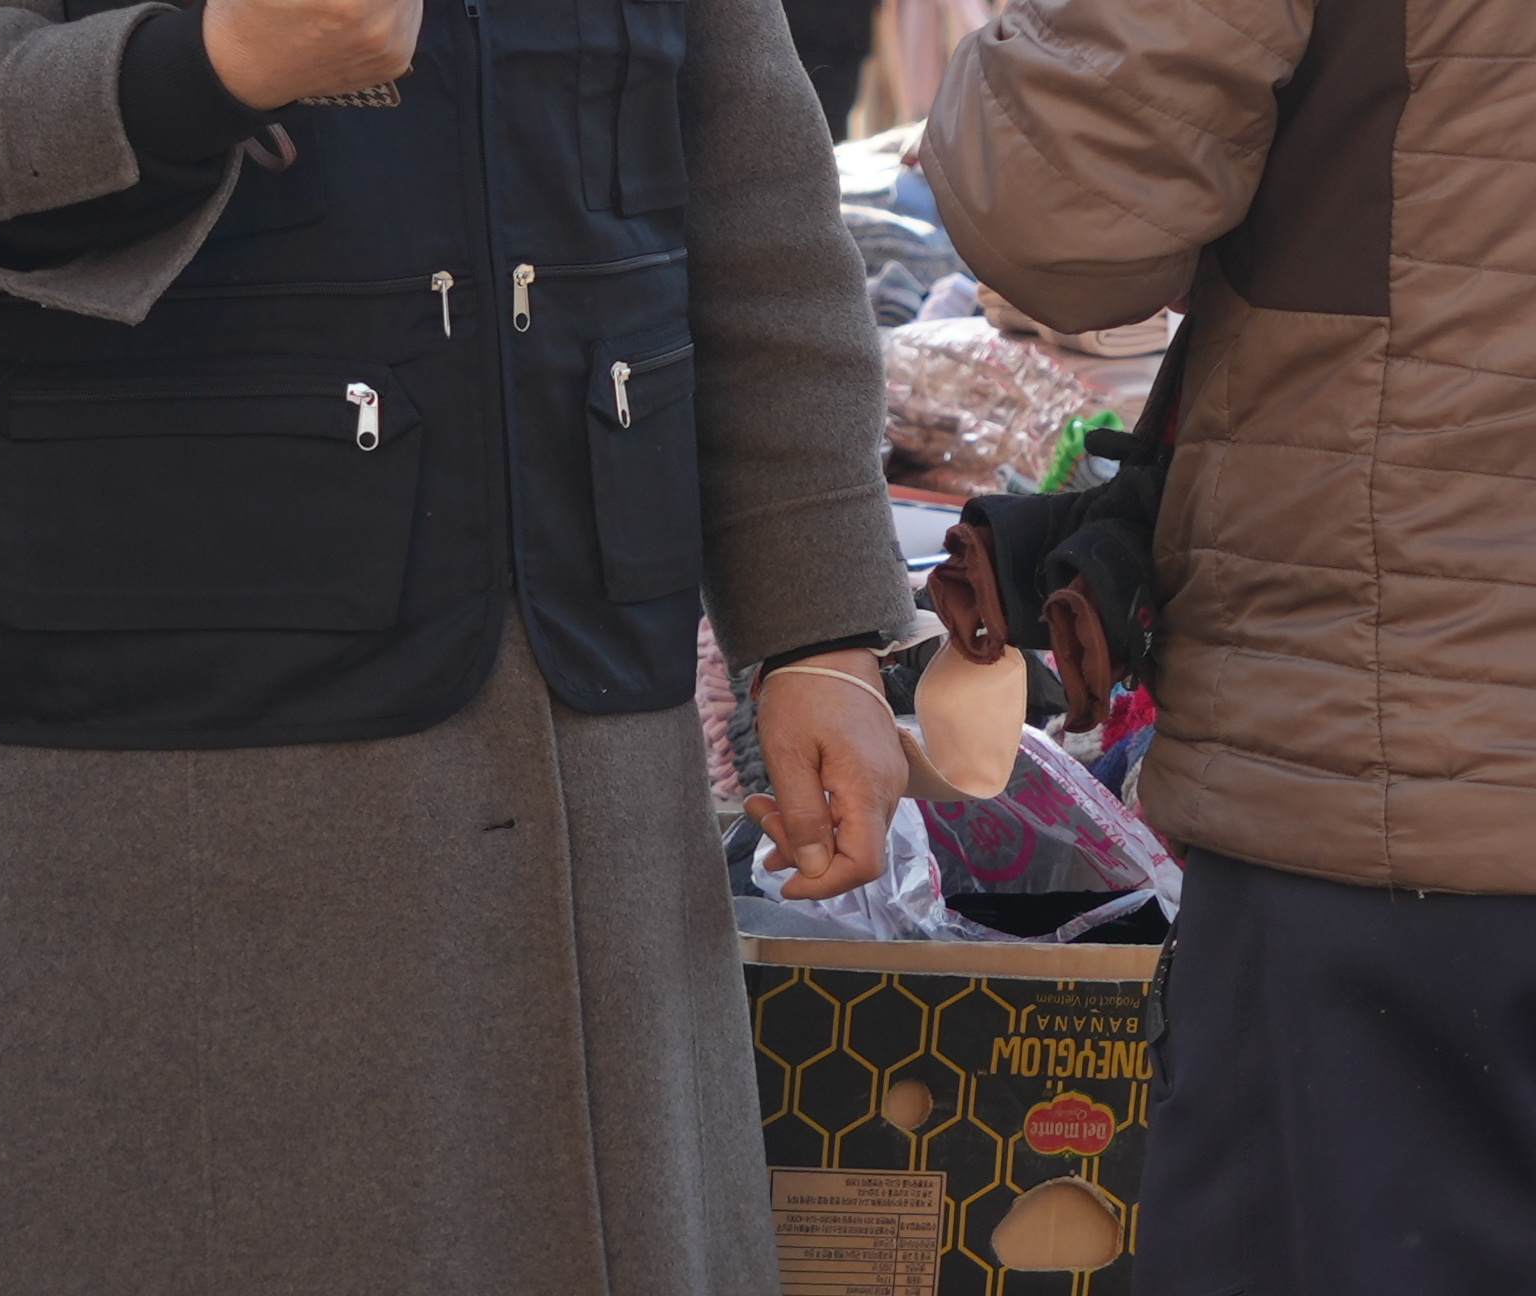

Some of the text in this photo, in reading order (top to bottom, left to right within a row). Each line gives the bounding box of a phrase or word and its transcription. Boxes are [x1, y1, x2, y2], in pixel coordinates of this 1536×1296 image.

[1036, 993, 1141, 1009] Product of Vietnam
[1036, 1014, 1139, 1033] BANANA
[990, 1036, 1154, 1080] ONEYGLOW
[1029, 1121, 1107, 1140] Del Monte
